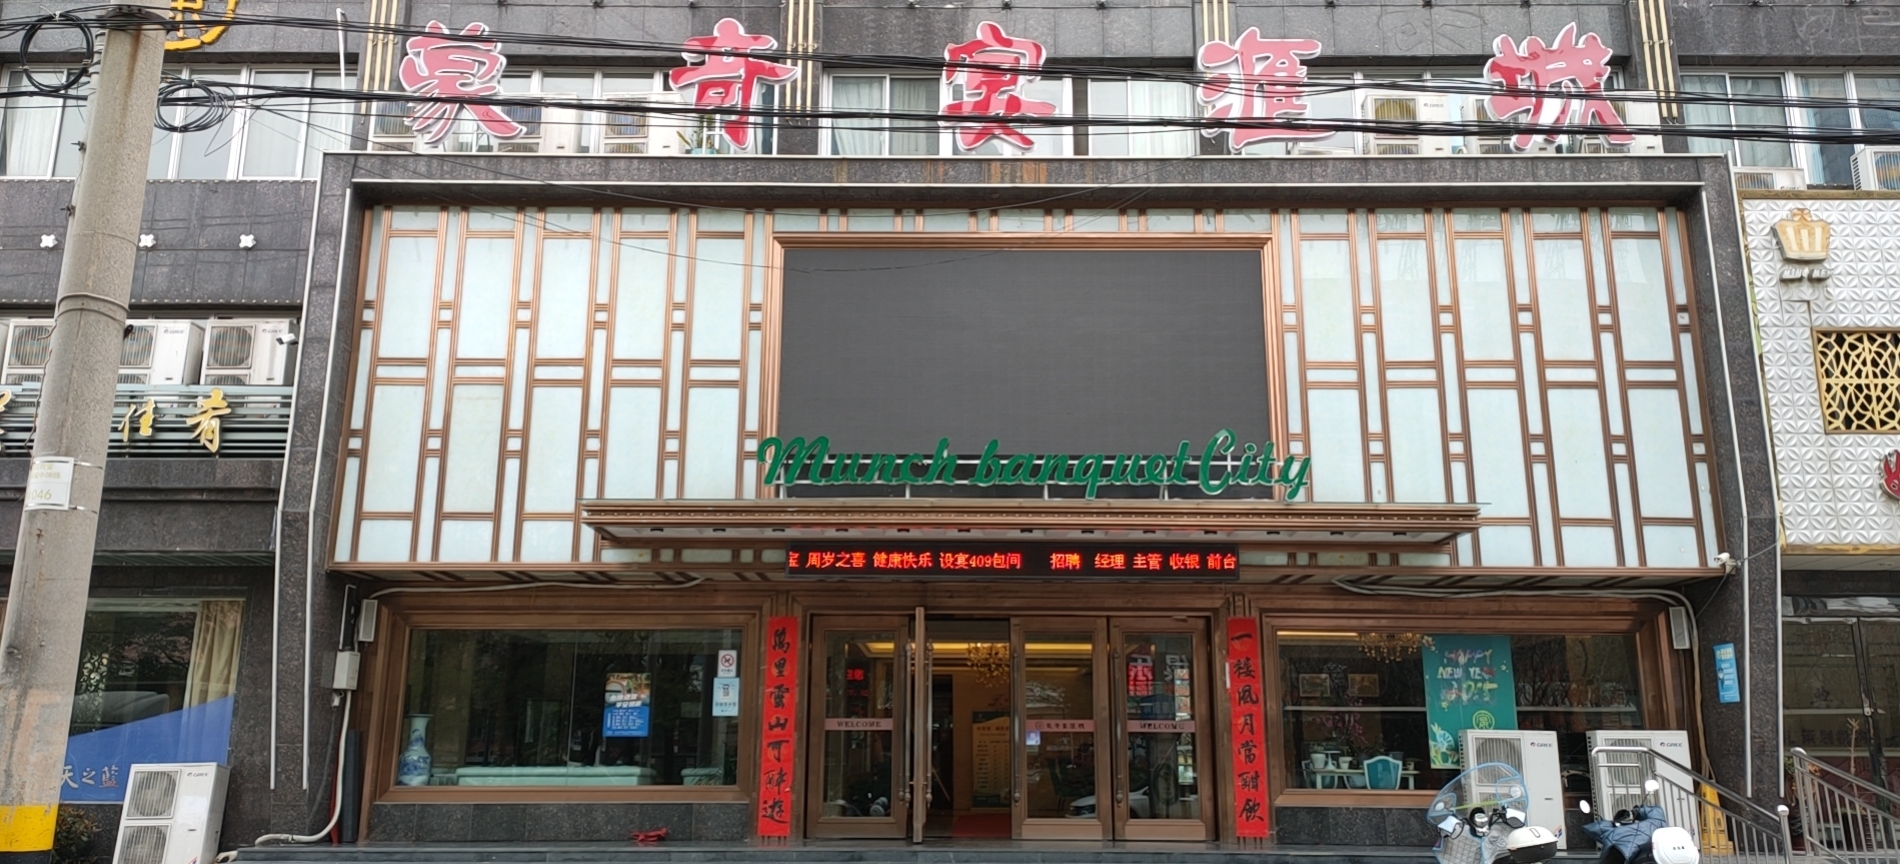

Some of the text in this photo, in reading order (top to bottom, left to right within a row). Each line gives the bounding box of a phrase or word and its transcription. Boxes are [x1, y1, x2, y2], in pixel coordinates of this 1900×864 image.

[759, 428, 1312, 501] Munch banquet City
[805, 551, 866, 568] 周岁之喜
[873, 551, 933, 568] 健康快乐
[939, 552, 1021, 569] 设宴409包间
[1050, 553, 1080, 569] 招聘
[1094, 553, 1125, 569] 经理
[1132, 553, 1162, 570] 主管
[1169, 553, 1199, 569] 收银
[1206, 553, 1237, 570] 前台
[1437, 666, 1464, 679] NEW
[1139, 722, 1184, 730] WELCOME
